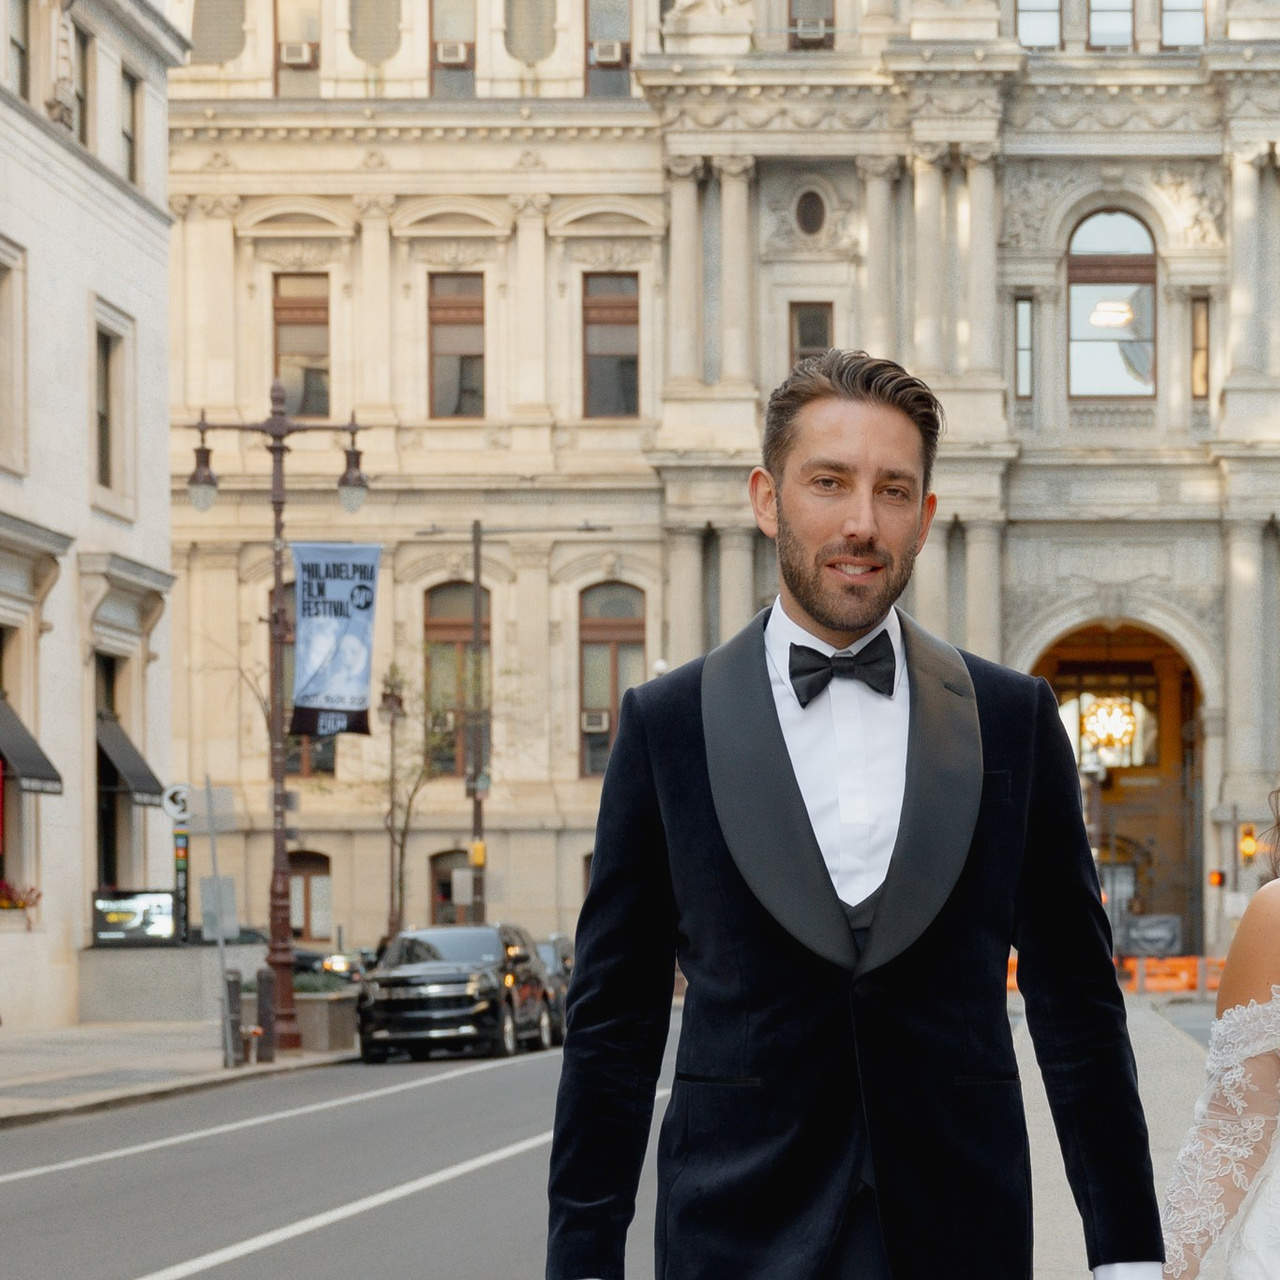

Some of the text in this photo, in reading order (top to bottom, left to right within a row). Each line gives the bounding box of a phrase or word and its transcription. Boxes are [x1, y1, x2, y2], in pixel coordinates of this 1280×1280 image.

[301, 563, 375, 581] PHILADELPHIA
[302, 581, 326, 598] FILM
[302, 600, 350, 618] FESTIVAL
